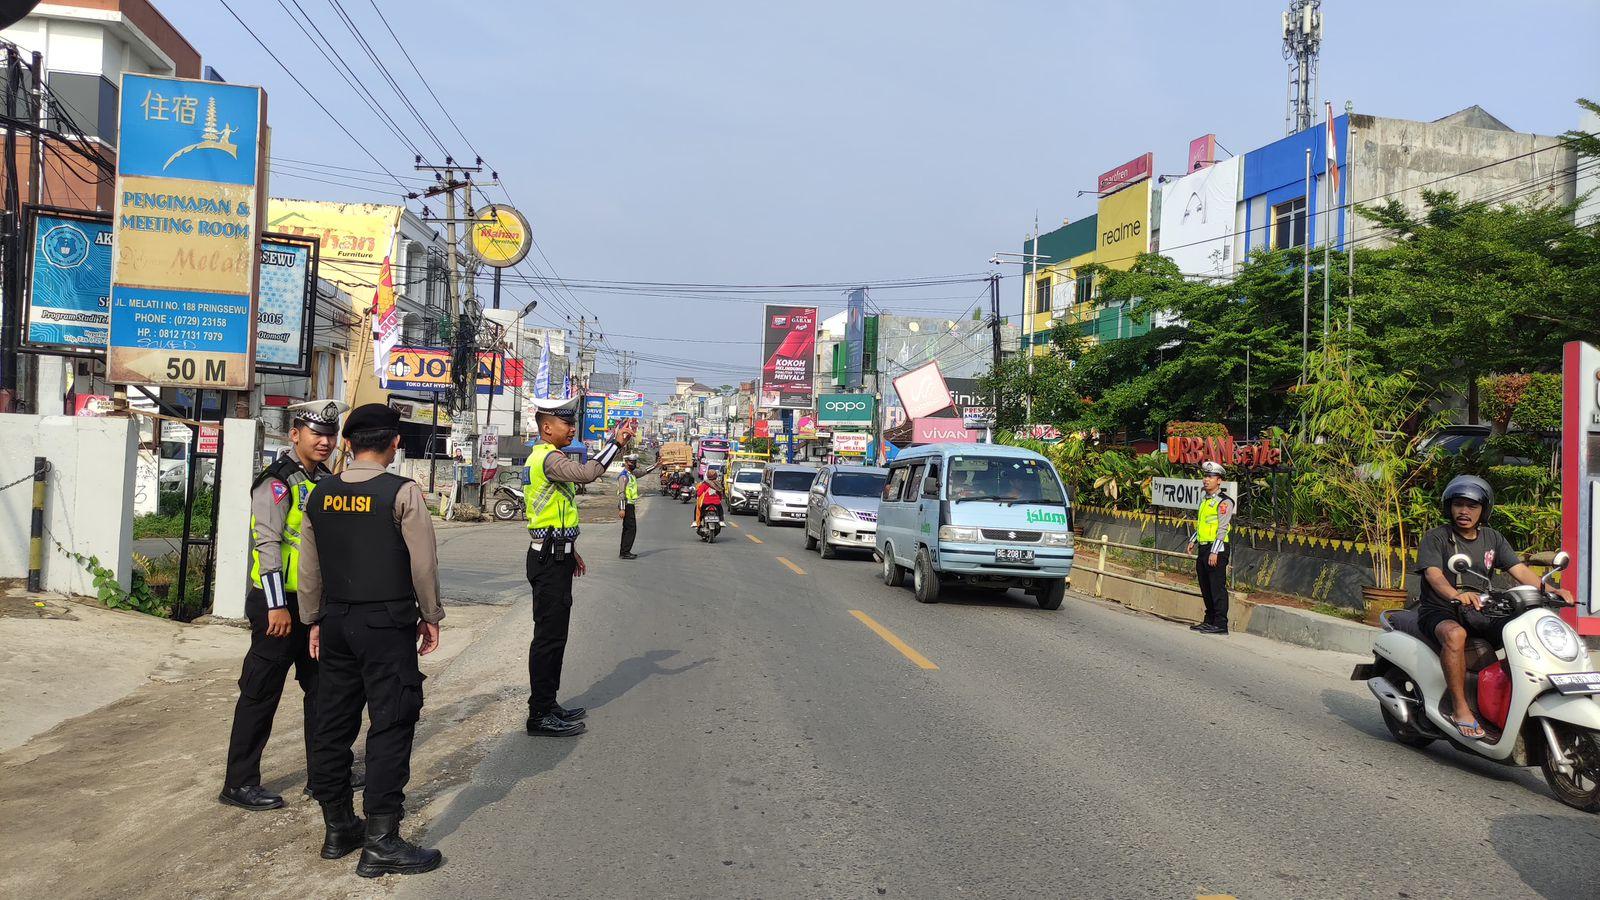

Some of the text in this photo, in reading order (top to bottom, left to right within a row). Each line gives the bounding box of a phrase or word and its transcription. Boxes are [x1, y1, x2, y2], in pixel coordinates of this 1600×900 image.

[140, 89, 199, 126] 住宿
[122, 191, 250, 218] PENGINAPAN &
[120, 214, 250, 239] MEETING ROOM
[481, 228, 520, 239] Mahan
[1102, 219, 1141, 247] realme
[261, 251, 295, 267] SEWU
[337, 250, 374, 259] Furniture
[115, 299, 127, 307] JL.
[129, 299, 159, 309] MELATI
[165, 301, 180, 310] NO.
[182, 302, 196, 311] 188
[197, 303, 247, 315] PRINGSEWU
[42, 310, 77, 321] Program
[79, 313, 98, 323] Studi
[135, 312, 167, 324] PHONE
[174, 316, 200, 327] (0729)
[202, 317, 227, 328] 23158
[137, 328, 151, 338] HP.
[159, 329, 179, 339] 0812
[181, 331, 200, 340] 7131
[203, 332, 223, 341] 7979
[166, 357, 227, 382] 50 M
[775, 359, 806, 367] KOKOH
[825, 401, 866, 412] oppo
[323, 495, 371, 512] POLISI
[997, 549, 1006, 558] BE
[1007, 550, 1021, 559] 2081
